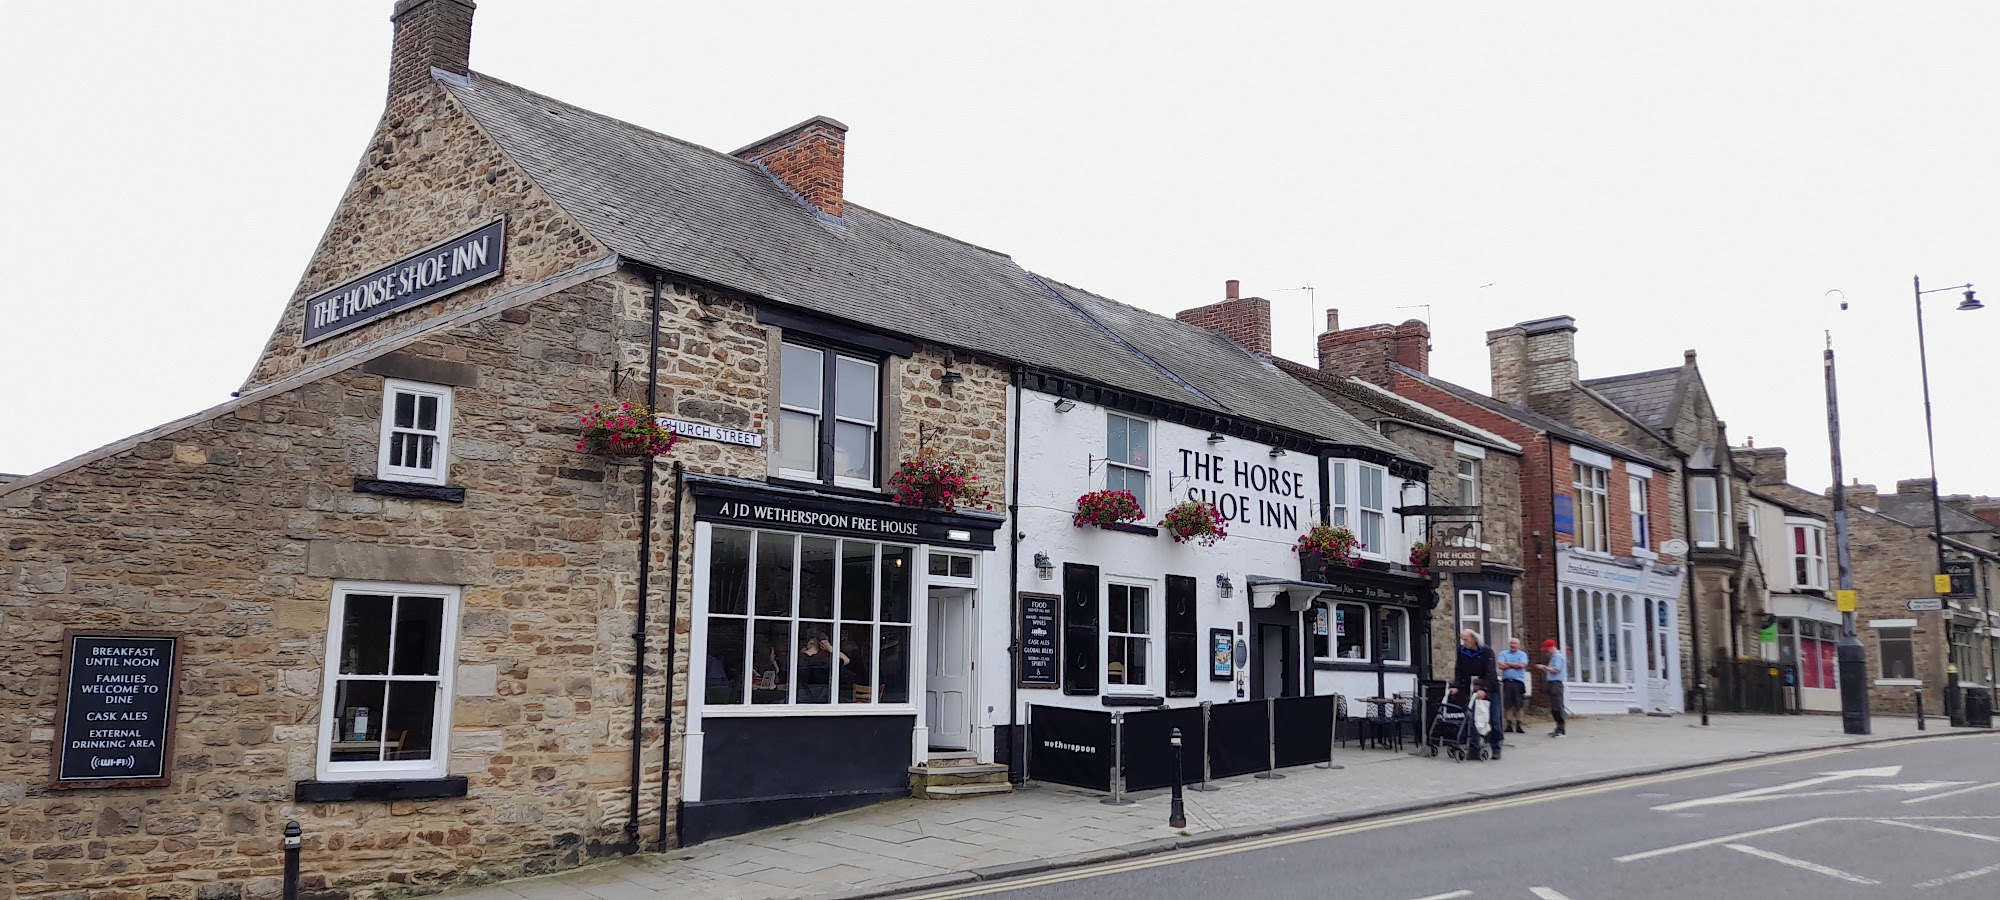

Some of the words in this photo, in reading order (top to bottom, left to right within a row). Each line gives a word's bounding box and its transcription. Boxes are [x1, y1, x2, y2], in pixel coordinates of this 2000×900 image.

[313, 295, 342, 329] THE
[343, 272, 397, 317] HORSE
[397, 252, 448, 297] SHOE
[451, 235, 489, 277] INN
[661, 420, 711, 438] CHURCH
[716, 428, 758, 445] STREET
[1178, 448, 1224, 484] THE
[1234, 460, 1304, 499] HORSE
[719, 502, 730, 515] A
[733, 503, 750, 518] JD
[754, 505, 848, 528] WETHERSPOON
[851, 516, 878, 531] FREE
[881, 520, 919, 535] HOUSE
[1259, 500, 1298, 531] INN
[1435, 551, 1450, 559] THE
[1451, 551, 1476, 559] HORSE
[1437, 559, 1457, 567] SHOE
[92, 647, 155, 657] BREAKFAST
[85, 657, 119, 667] UNTIL
[122, 658, 160, 667] NOON
[96, 674, 147, 683] FAMILIES
[81, 684, 139, 694] WELCOME
[142, 684, 159, 694] TO
[105, 695, 134, 704] DINE
[86, 711, 118, 721] CASK
[120, 711, 148, 721] ALES
[89, 729, 142, 738] EXTERNAL
[72, 740, 126, 749] DRINKING
[128, 739, 156, 748] AREA
[1044, 740, 1096, 753] wetherspoon
